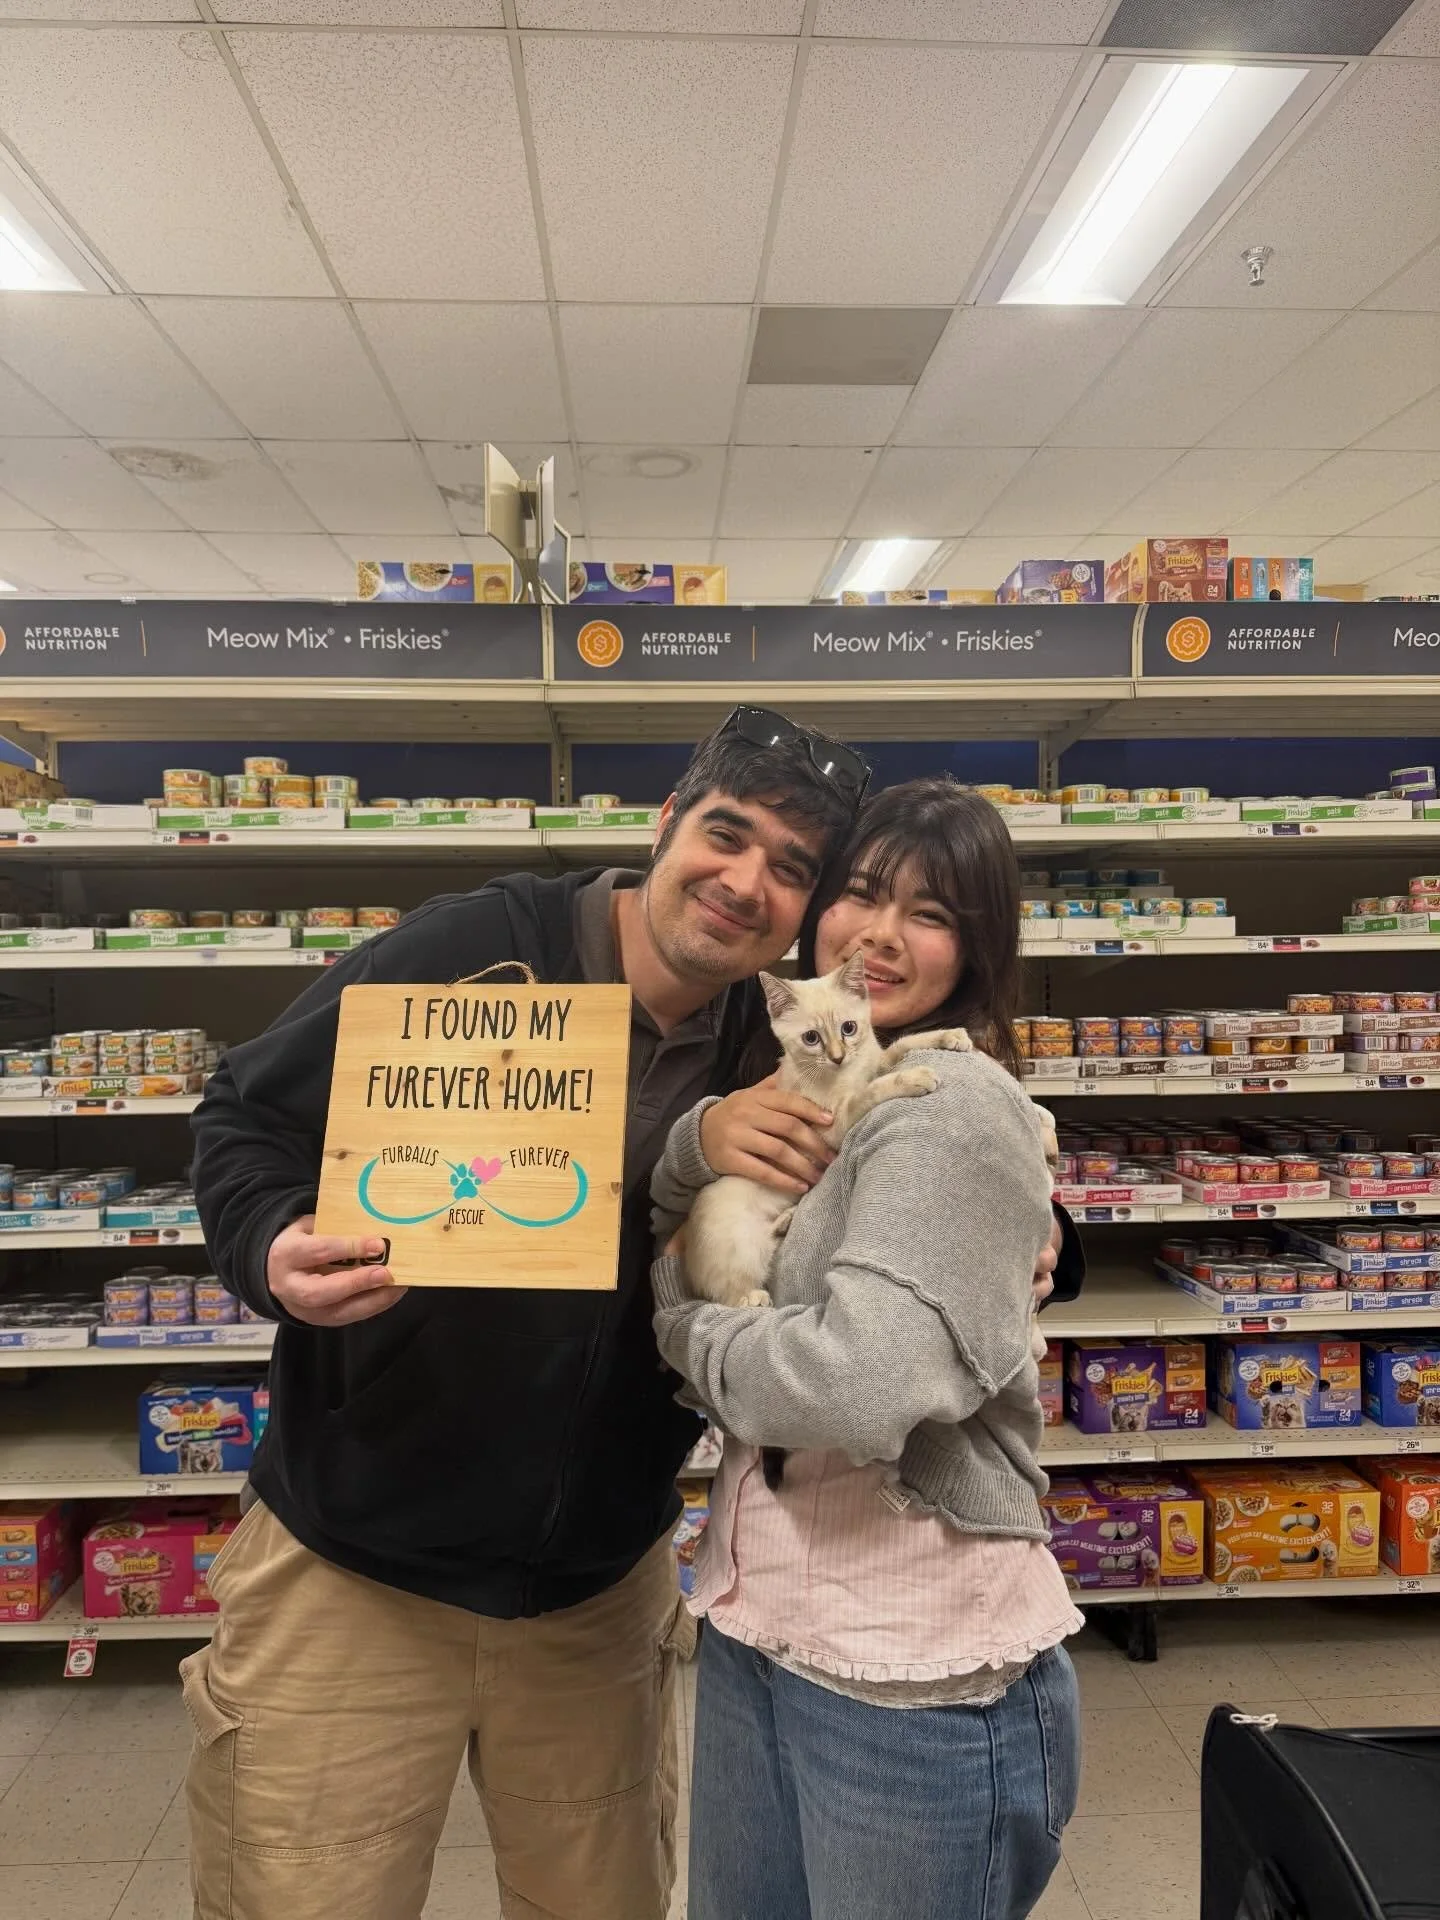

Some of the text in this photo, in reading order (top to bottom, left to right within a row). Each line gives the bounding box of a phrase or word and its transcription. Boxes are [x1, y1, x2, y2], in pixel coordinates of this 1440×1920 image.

[24, 627, 120, 638] AFFORDABLE
[207, 627, 279, 648] Meow
[641, 632, 732, 643] AFFORDABLE
[1228, 628, 1316, 639] AFFORDABLE
[26, 639, 108, 650] NUTRITION
[813, 632, 880, 652] Meow
[1228, 640, 1302, 650] NUTRITION
[642, 644, 718, 655] NUTRITION
[401, 997, 573, 1042] I FOUND MY
[92, 1078, 124, 1089] FARM
[366, 1065, 593, 1114] FUREVER HOME!
[381, 1145, 439, 1167] FURBALLS
[509, 1146, 570, 1171] FUREVER
[448, 1207, 485, 1226] RESCUE
[1265, 1371, 1298, 1383] Friskies
[1185, 1408, 1199, 1418] 24
[1339, 1408, 1351, 1417] 24
[1321, 1501, 1334, 1510] 32
[1141, 1509, 1154, 1518] 32
[1290, 1526, 1333, 1545] EXCITEMENT!
[1108, 1535, 1153, 1555] EXCITEMENT!
